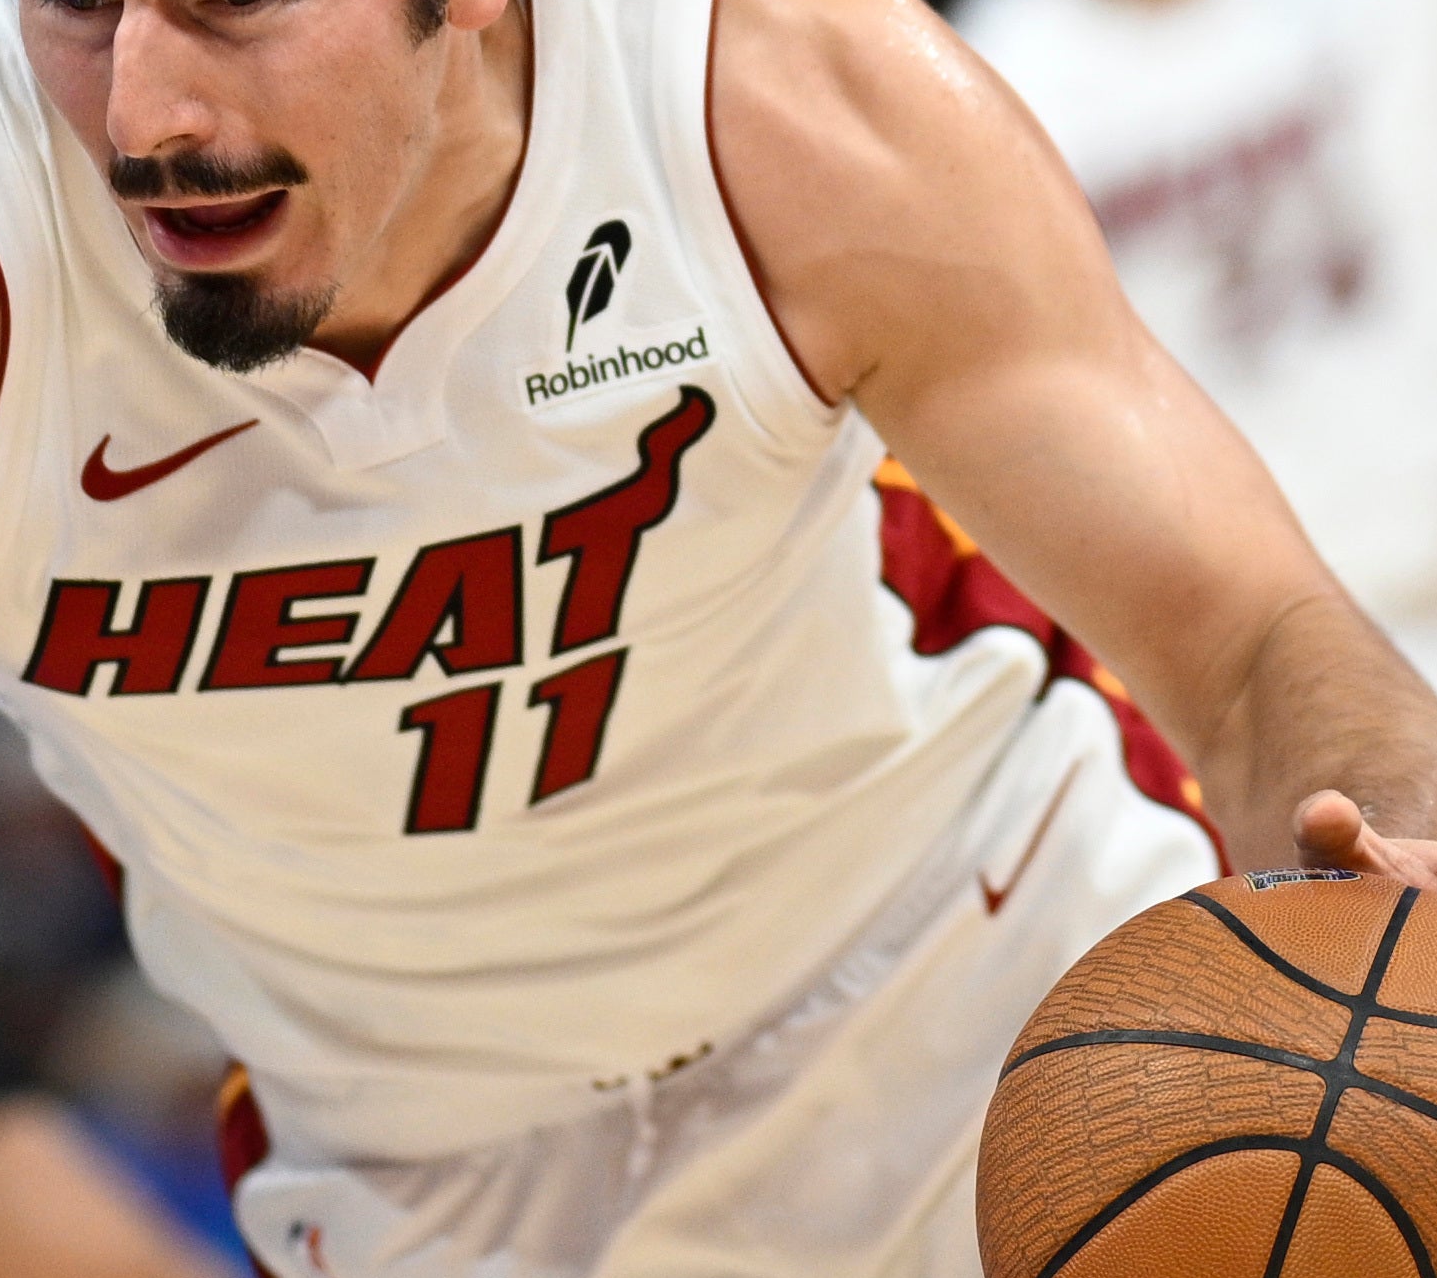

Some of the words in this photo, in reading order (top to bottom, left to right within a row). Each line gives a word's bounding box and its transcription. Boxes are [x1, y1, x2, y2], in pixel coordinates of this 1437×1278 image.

[525, 325, 710, 406] Robinhood
[22, 383, 717, 698] HEAT
[399, 646, 630, 836] 11
